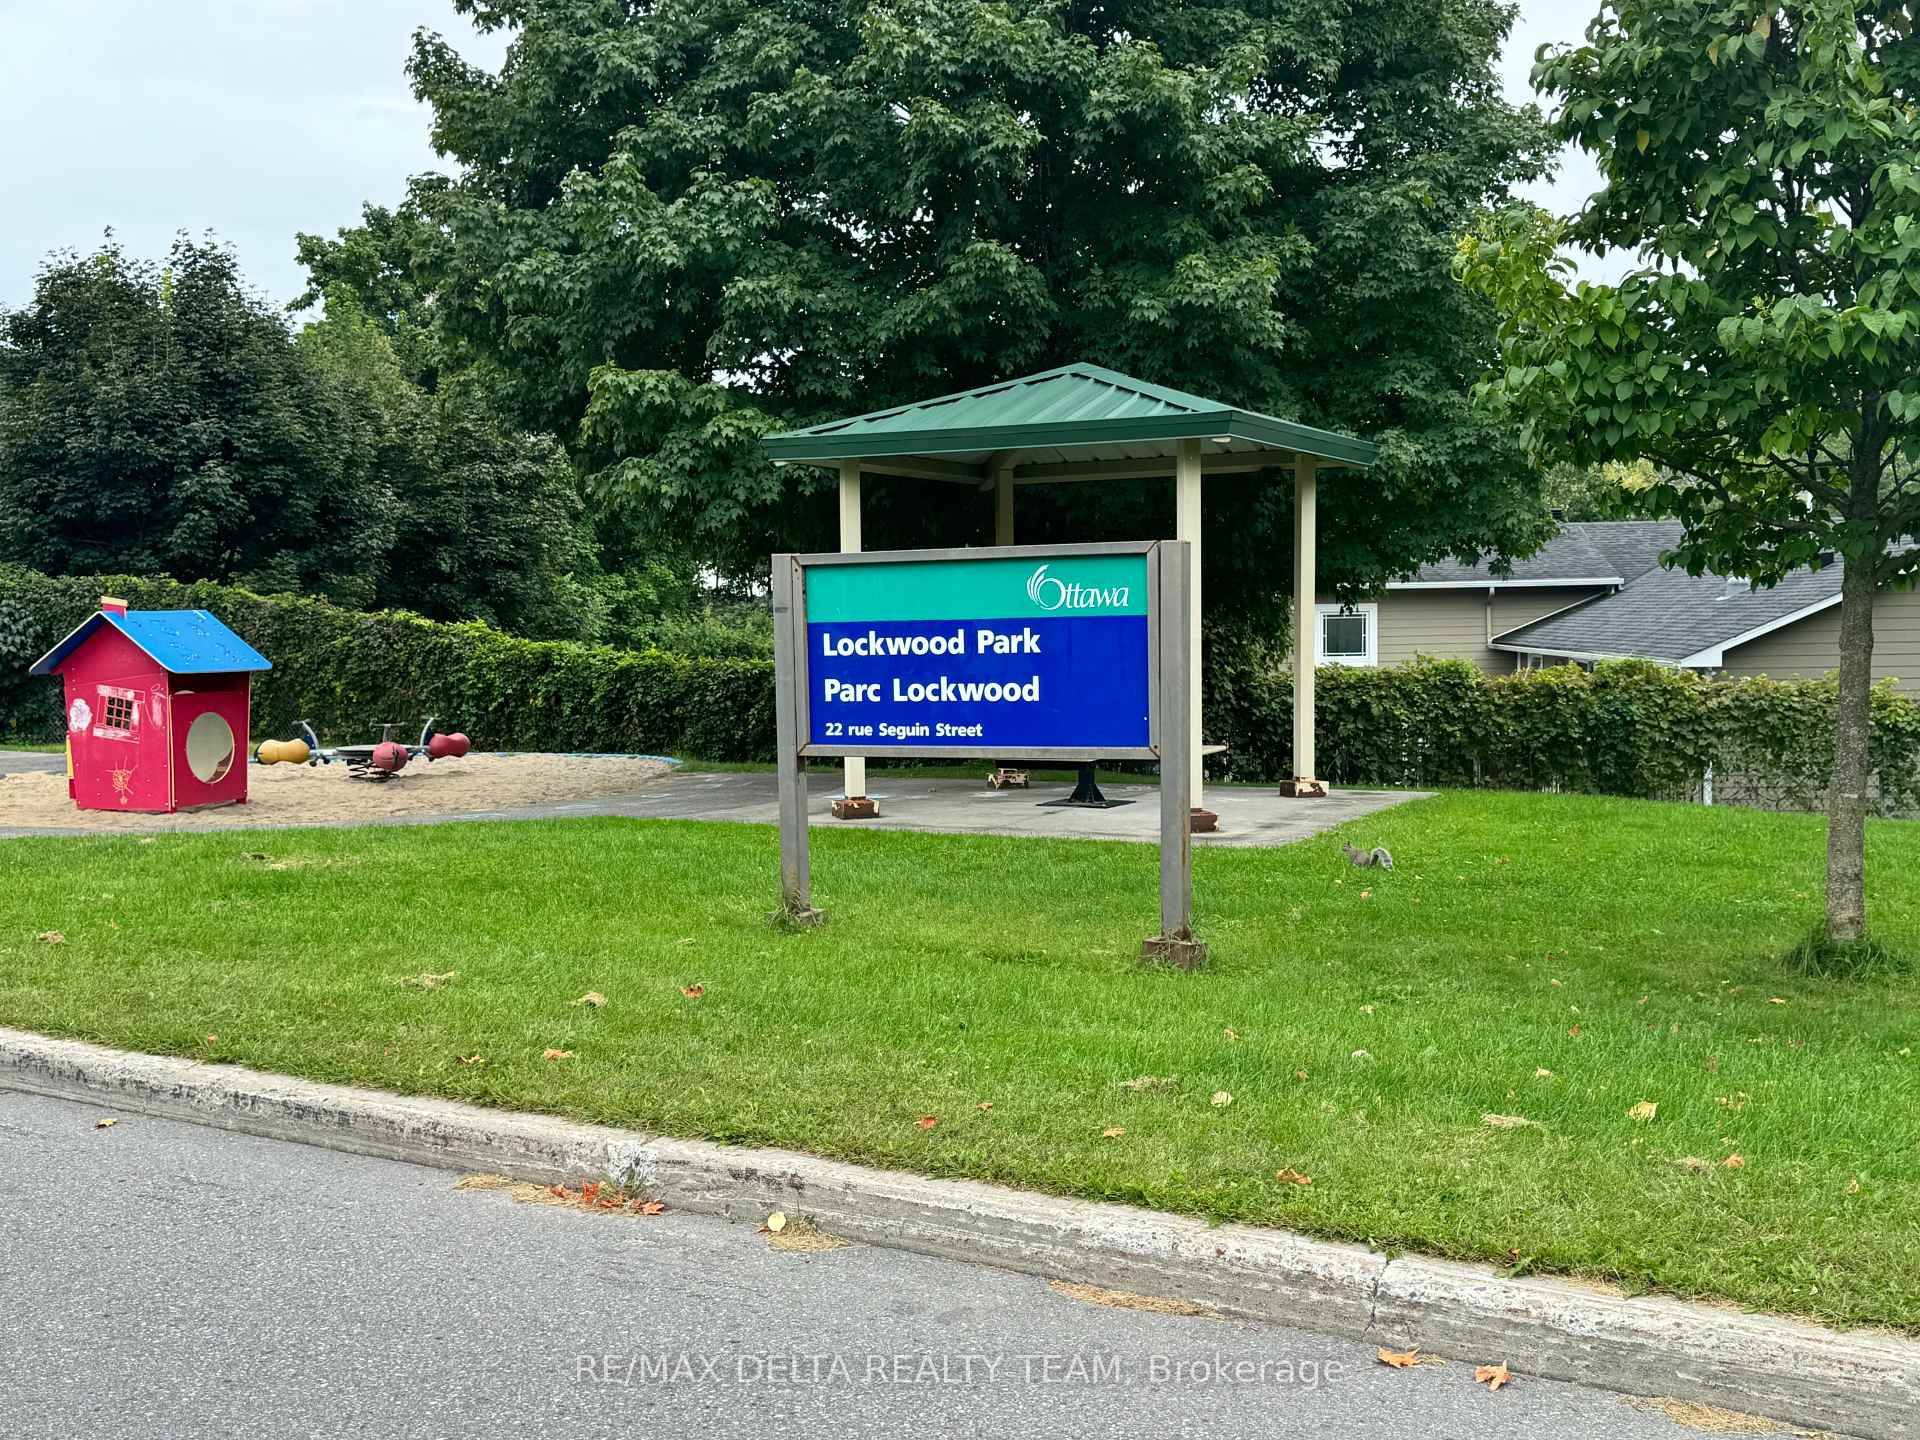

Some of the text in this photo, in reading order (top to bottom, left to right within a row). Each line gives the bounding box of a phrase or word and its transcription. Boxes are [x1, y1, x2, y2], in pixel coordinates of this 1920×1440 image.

[1036, 576, 1129, 610] Ottawa
[823, 627, 1041, 657] Lockwood Park
[824, 676, 1040, 703] Parc Lockwood
[825, 722, 983, 740] 22 rue Seguin Street
